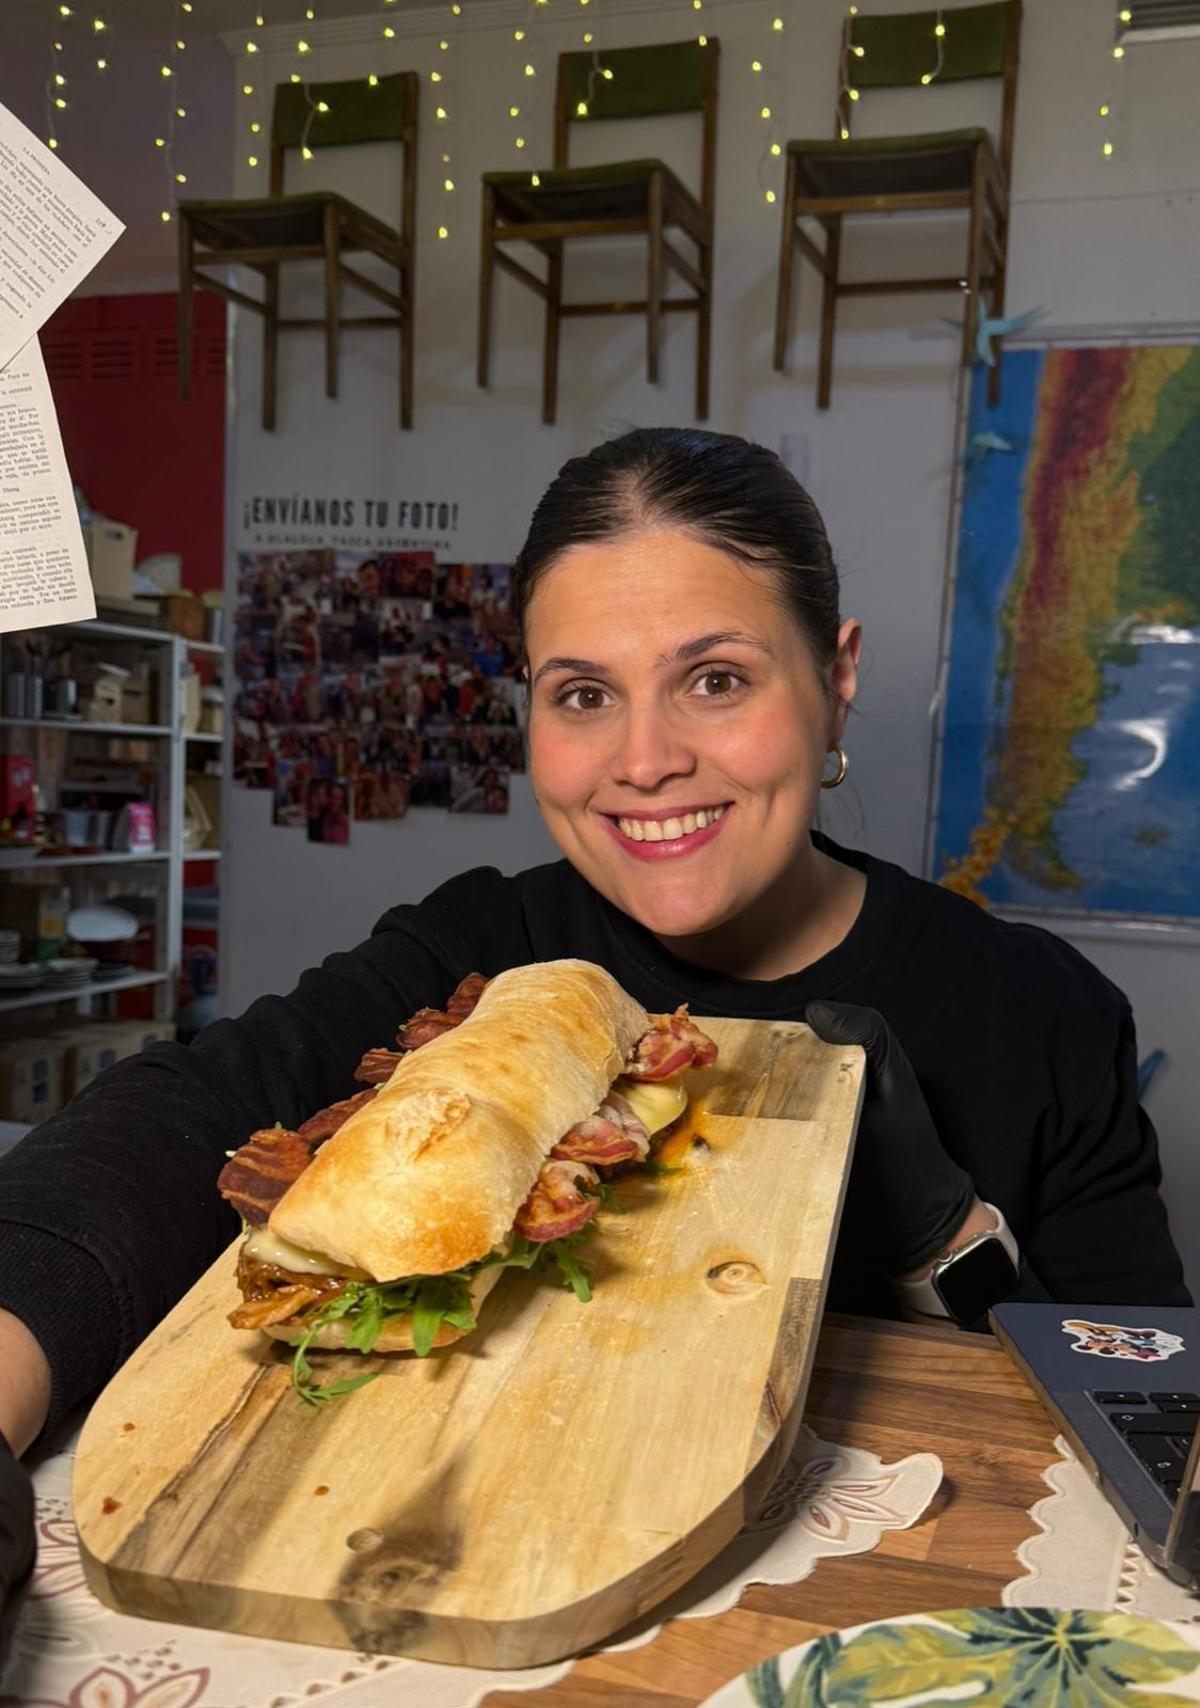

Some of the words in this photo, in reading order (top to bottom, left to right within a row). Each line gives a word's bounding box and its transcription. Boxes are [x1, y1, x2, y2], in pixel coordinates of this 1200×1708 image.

[243, 495, 355, 530] ¡ENVÍANOS
[365, 500, 389, 528] TU
[397, 501, 459, 531] FOTO!
